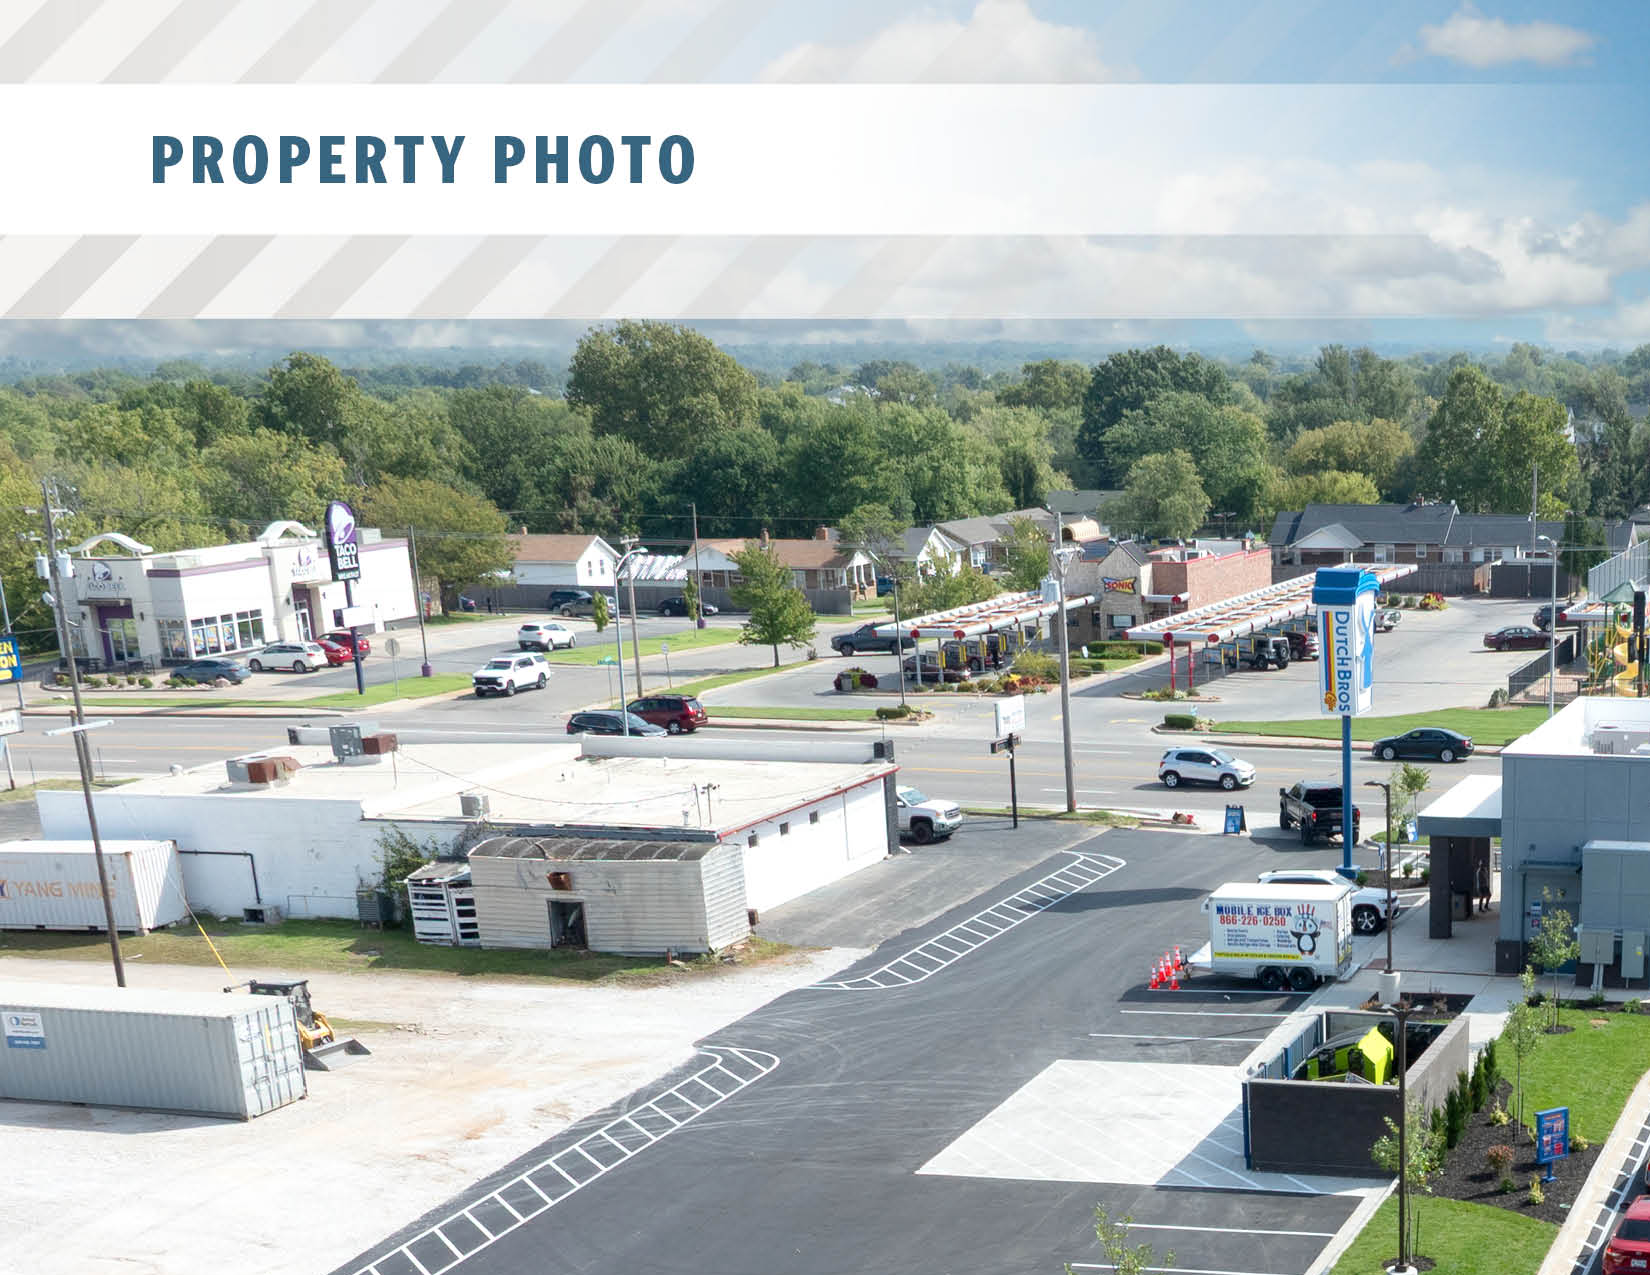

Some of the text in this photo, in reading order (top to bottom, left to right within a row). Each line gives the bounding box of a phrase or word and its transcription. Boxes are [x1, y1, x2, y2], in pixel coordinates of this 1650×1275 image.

[334, 543, 357, 557] TACO
[337, 556, 359, 570] BELL
[1105, 581, 1133, 590] SONIC
[1335, 611, 1352, 712] DUTCH BROS
[13, 881, 63, 897] YANG
[1216, 904, 1292, 917] MOBILE ICE BOX
